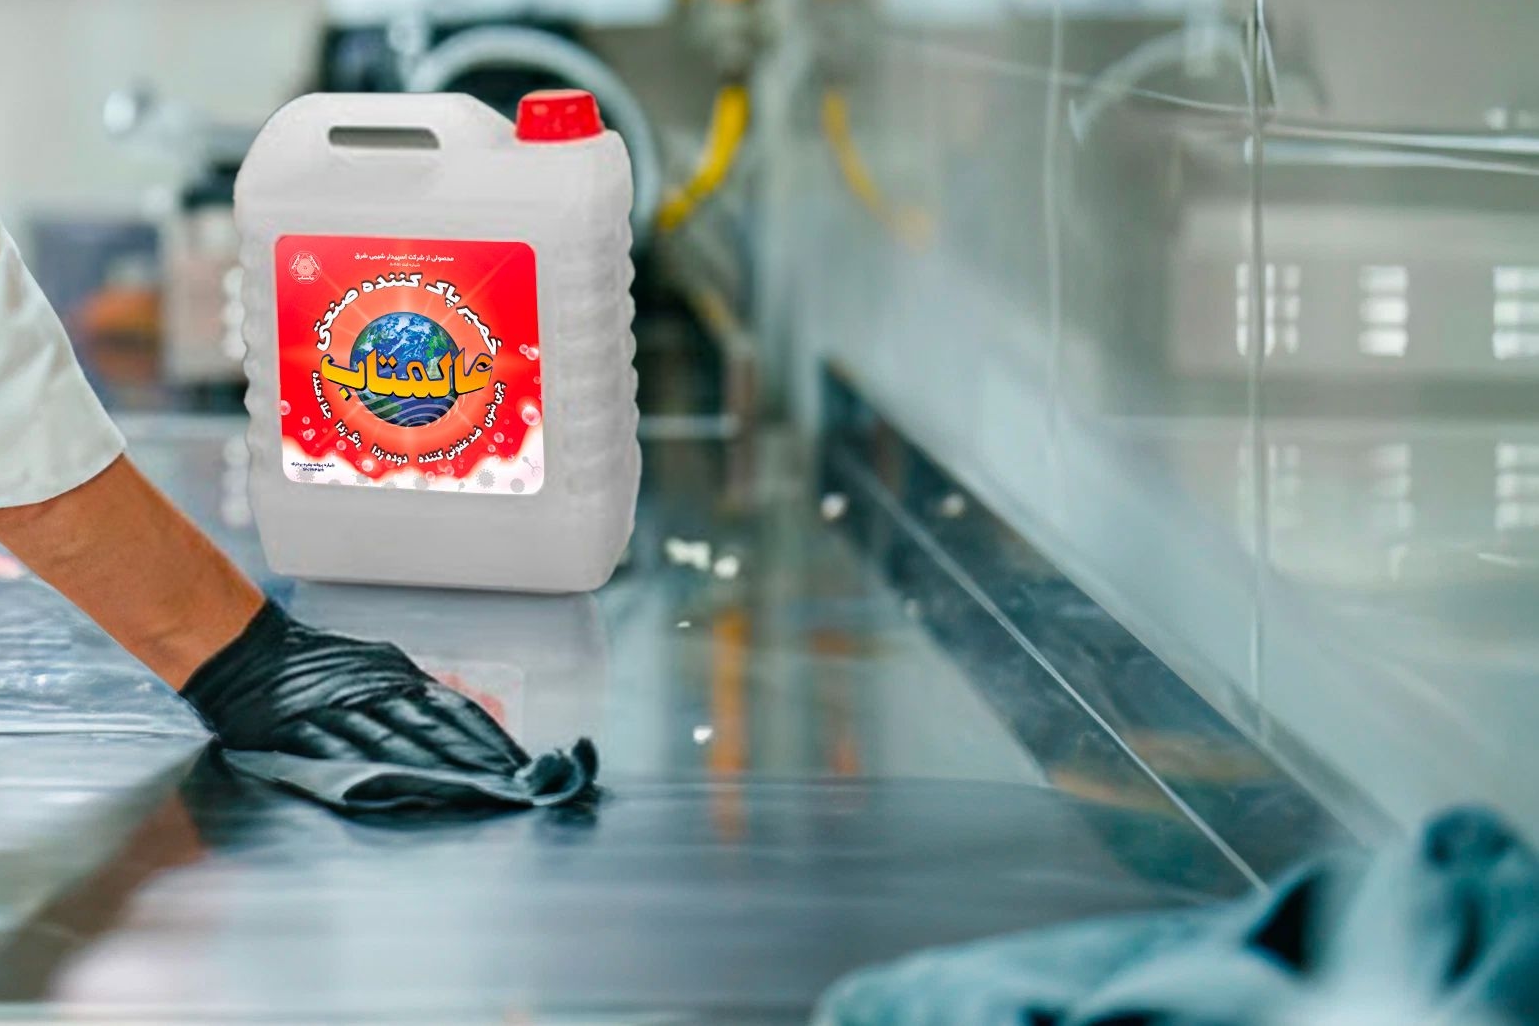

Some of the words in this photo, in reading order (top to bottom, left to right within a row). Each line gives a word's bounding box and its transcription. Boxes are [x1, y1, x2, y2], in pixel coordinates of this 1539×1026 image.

[362, 273, 422, 293] کننده
[425, 280, 461, 308] پاک
[313, 288, 359, 351] صنعتی
[456, 305, 503, 356] خمیر
[320, 347, 494, 402] عالمتاب
[418, 450, 444, 464] کننده
